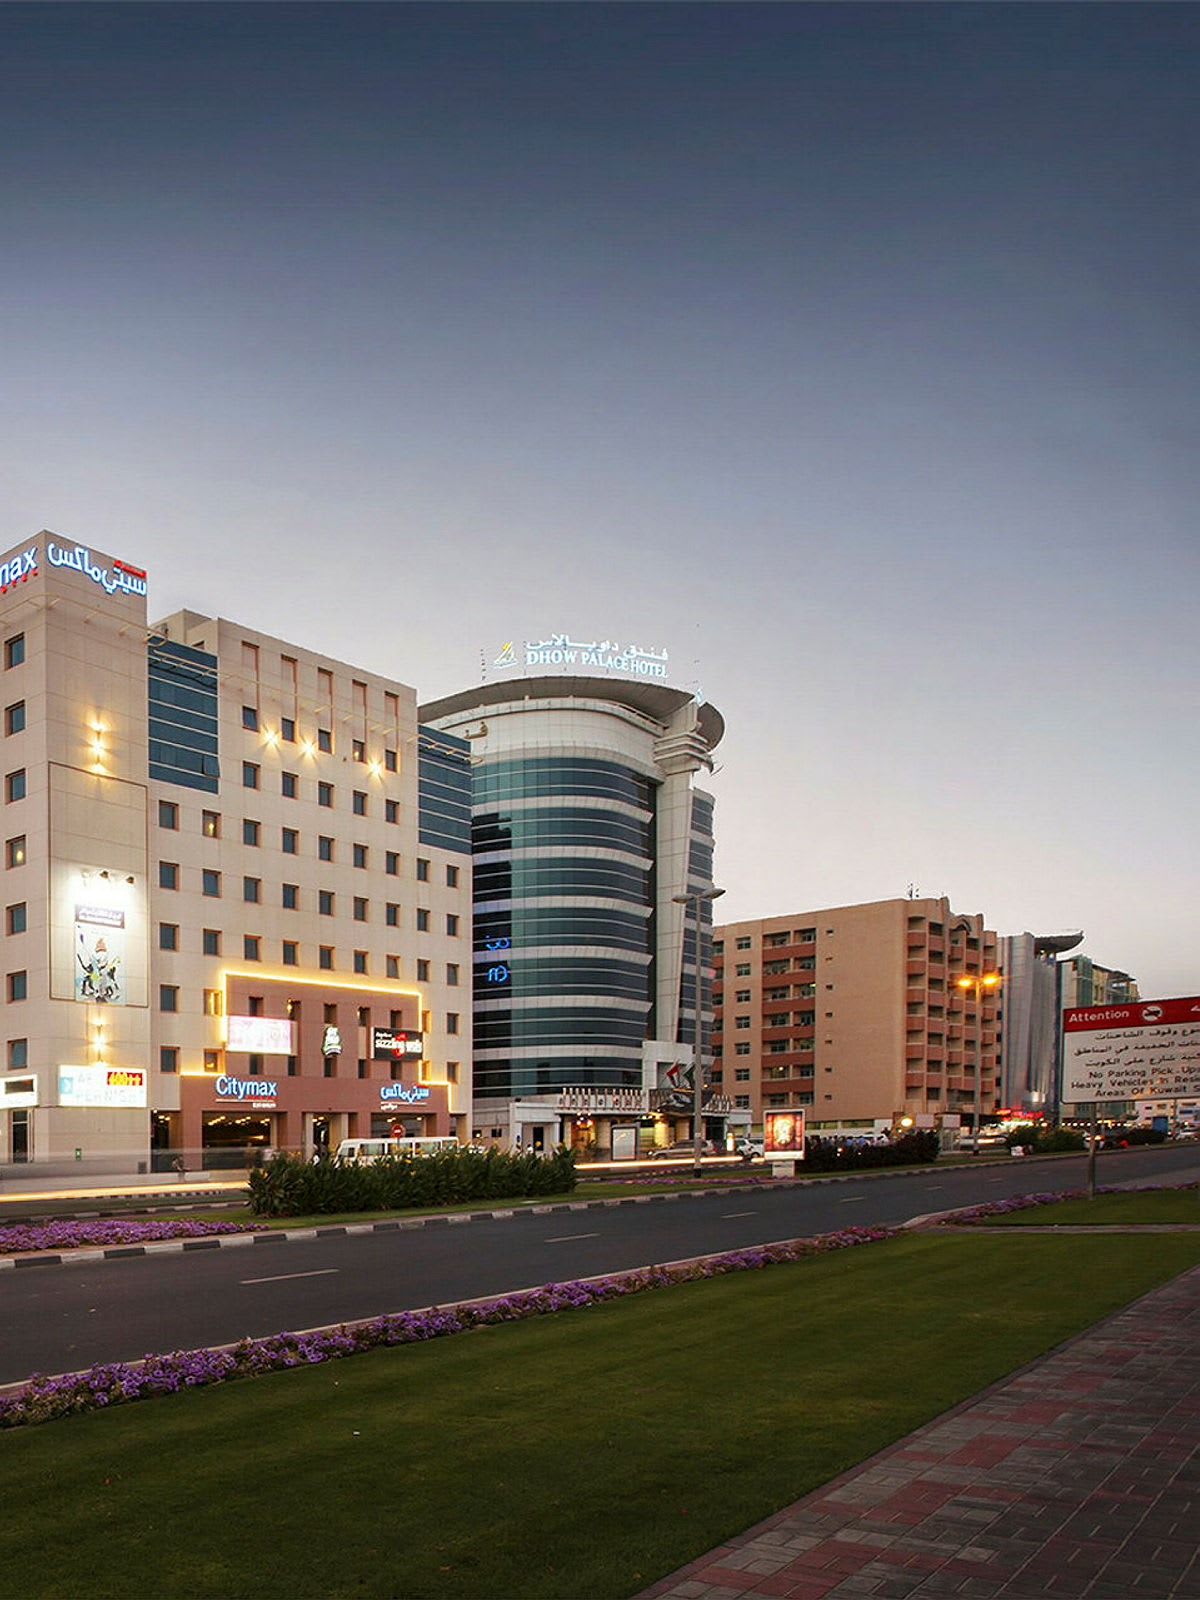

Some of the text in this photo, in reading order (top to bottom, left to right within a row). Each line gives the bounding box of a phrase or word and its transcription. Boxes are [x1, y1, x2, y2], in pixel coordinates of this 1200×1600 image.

[526, 649, 668, 678] DHOW PALACE HOTEL
[1069, 1010, 1129, 1023] Attention
[1088, 1071, 1103, 1079] No
[1107, 1069, 1146, 1078] Parking
[1151, 1066, 1173, 1075] Pick
[216, 1076, 277, 1099] Citymax
[1071, 1081, 1103, 1089] Heavy
[1109, 1076, 1154, 1087] Vehicles
[1095, 1089, 1126, 1097] Areas
[1150, 1085, 1187, 1094] Kuwait
